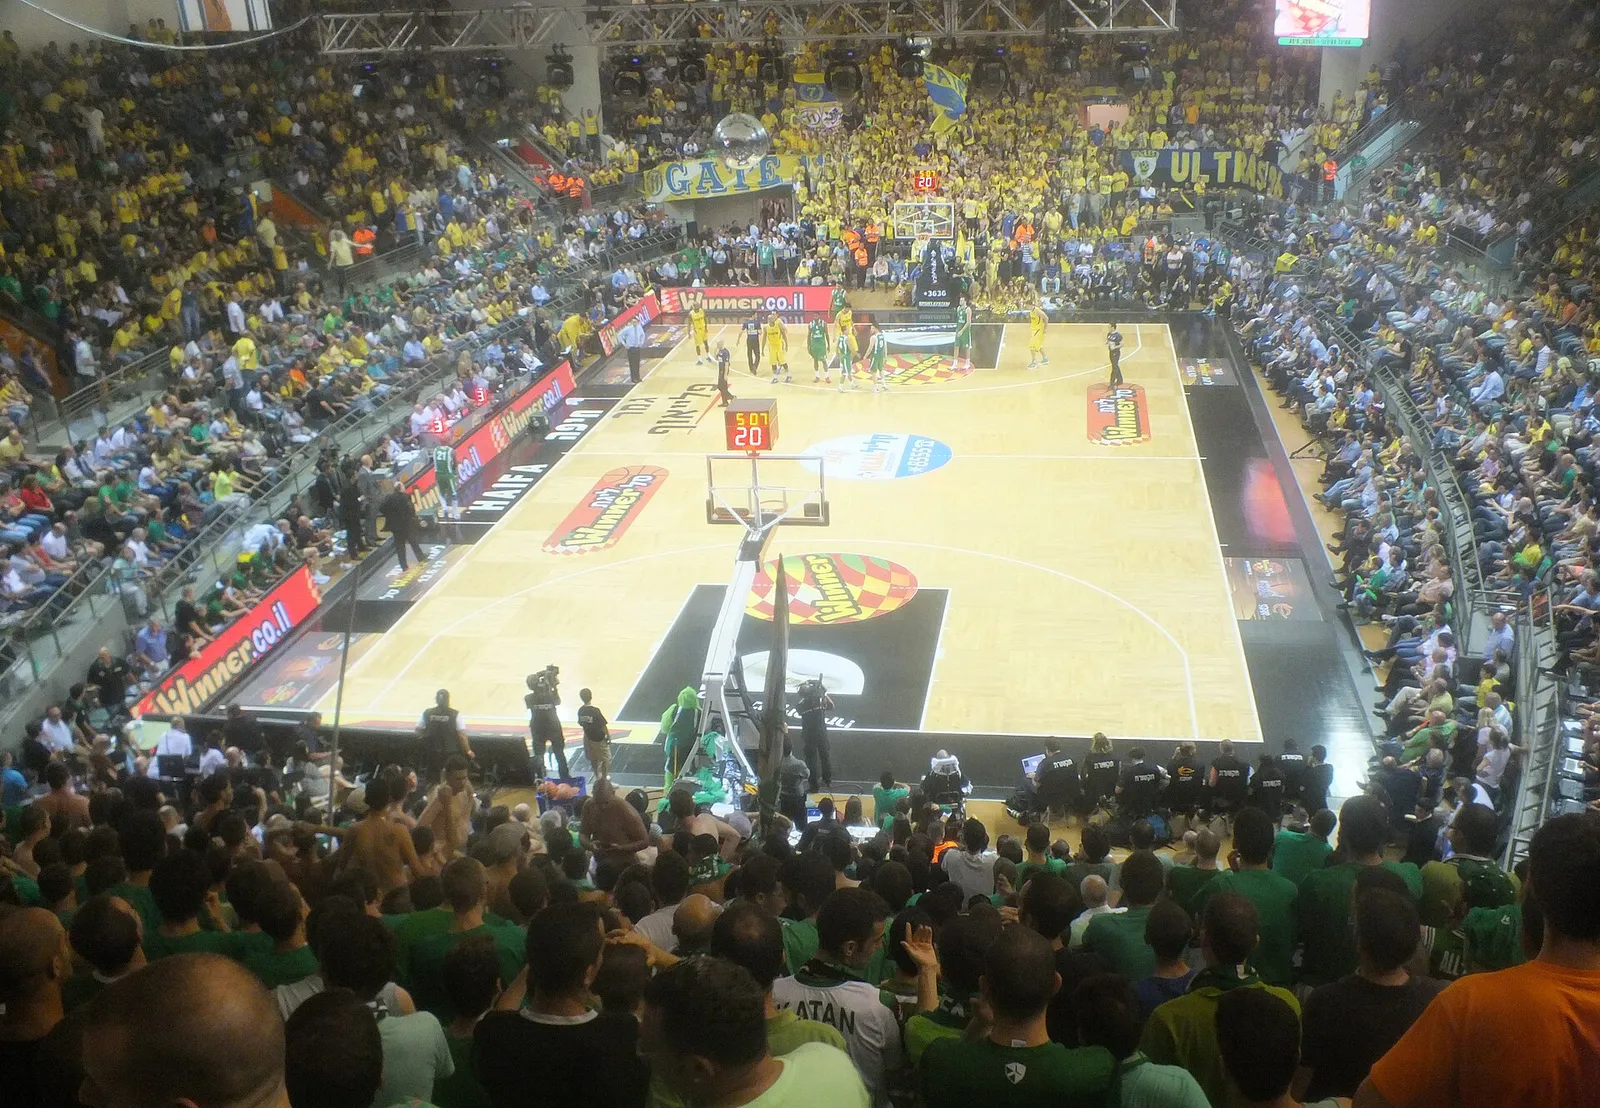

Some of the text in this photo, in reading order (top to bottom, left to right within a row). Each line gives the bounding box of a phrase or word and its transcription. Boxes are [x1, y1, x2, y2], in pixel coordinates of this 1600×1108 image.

[665, 155, 784, 197] GATE
[918, 177, 932, 187] 20
[679, 291, 804, 311] Winner.co.il
[735, 427, 762, 446] 20
[1104, 398, 1139, 440] Winner
[436, 450, 447, 461] 21
[468, 463, 549, 511] HAIFA
[562, 487, 642, 546] Winner
[804, 554, 859, 622] Winner
[156, 600, 293, 715] Winner.co.il
[776, 1000, 856, 1035] ATAN
